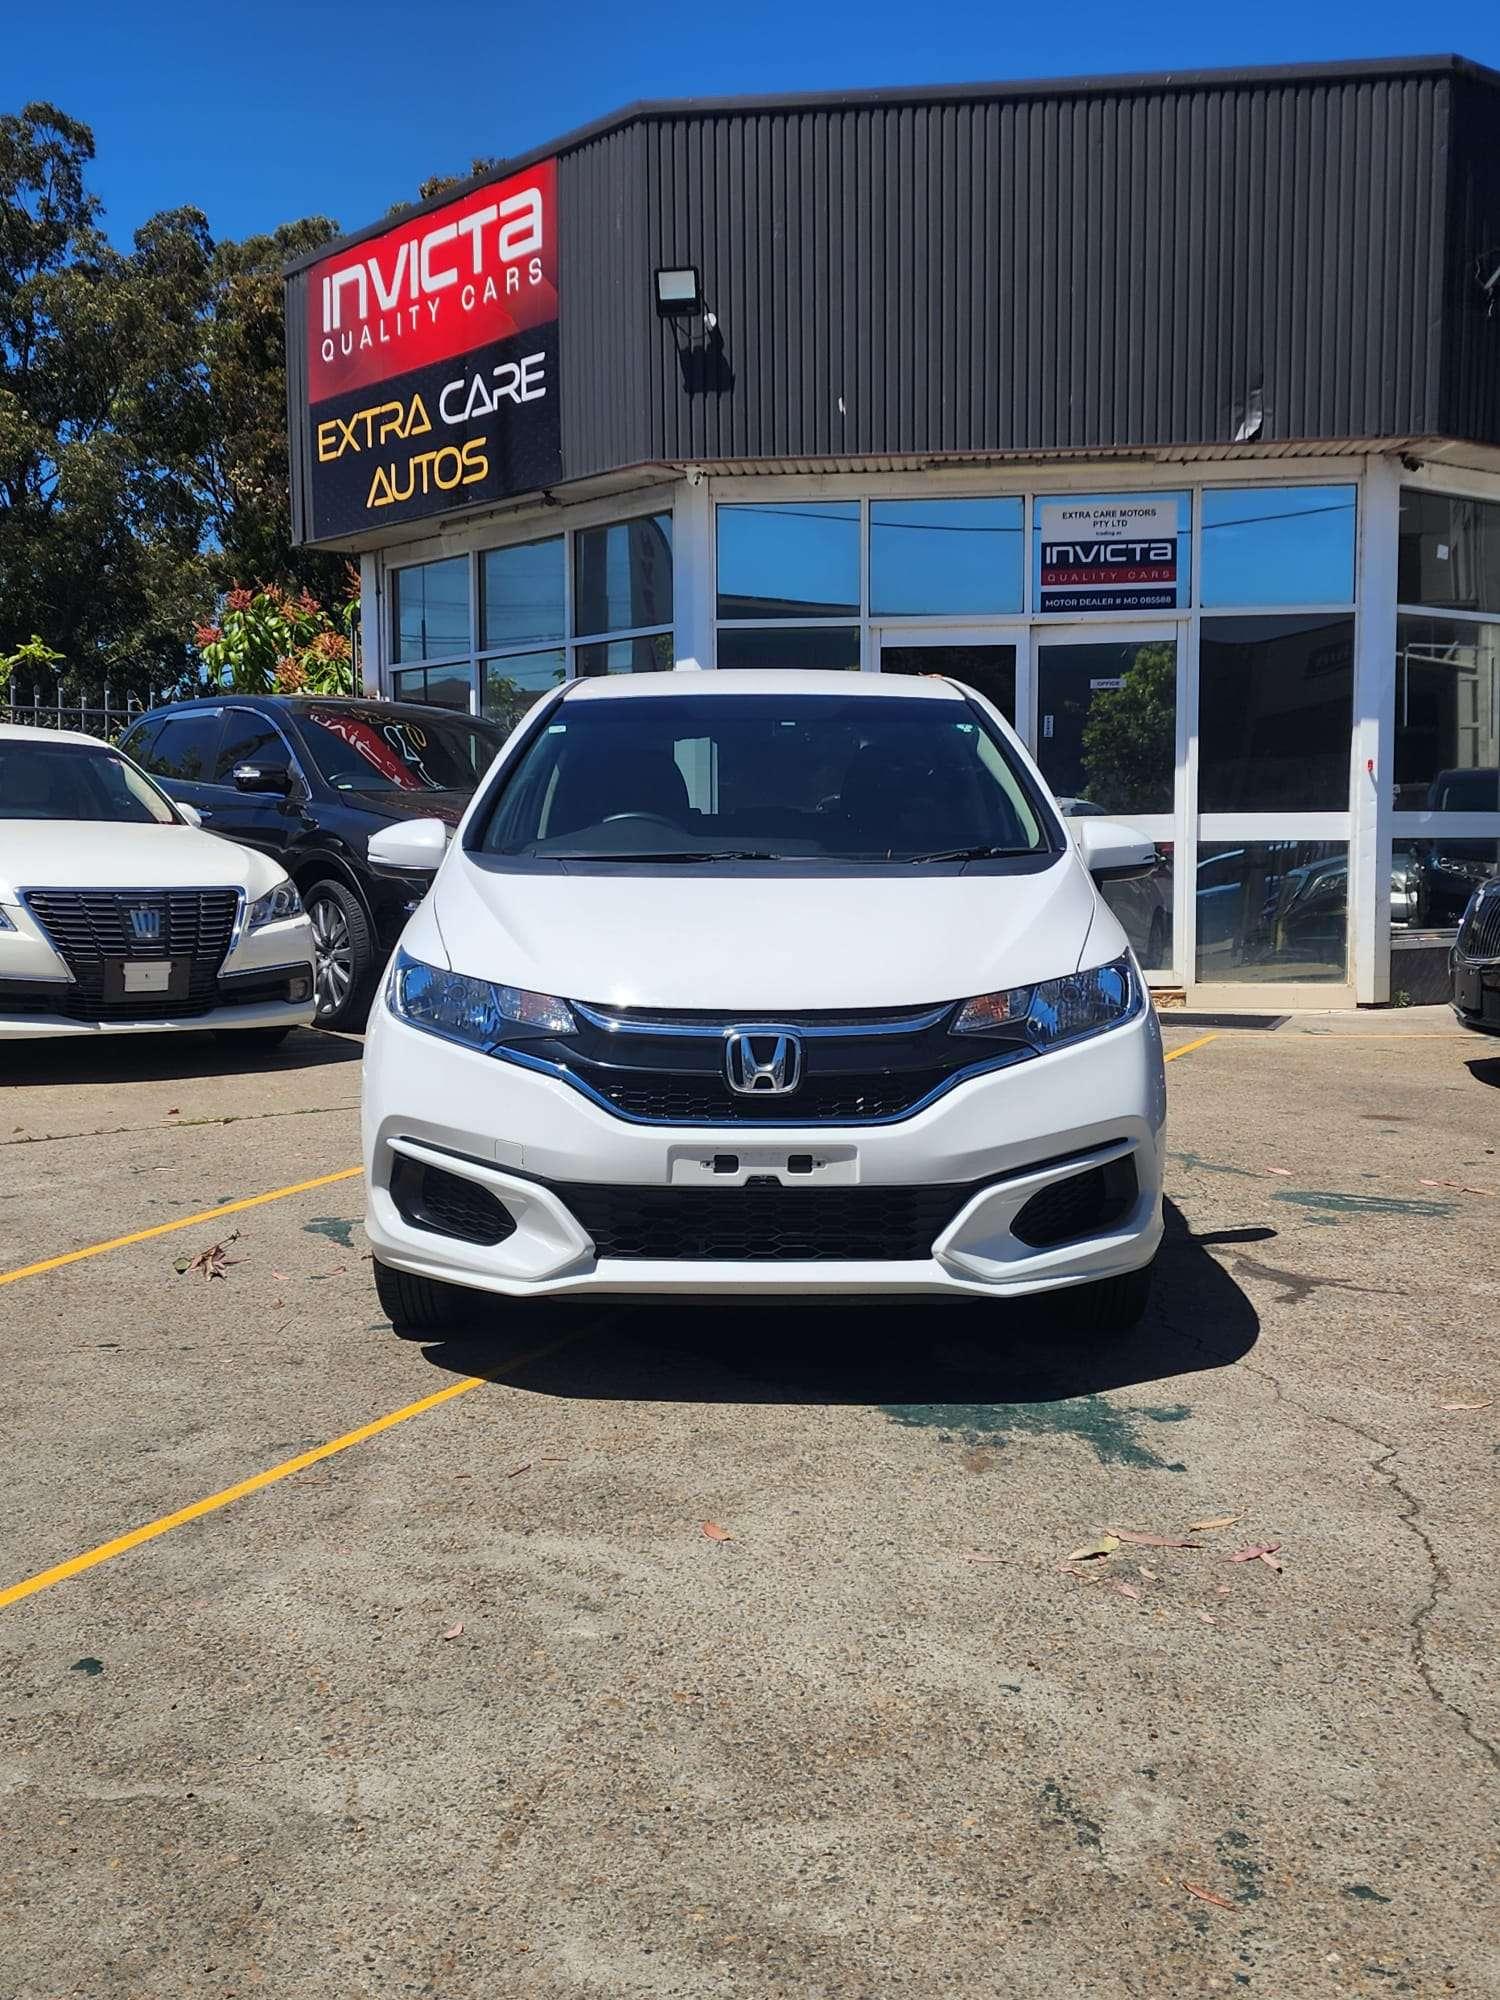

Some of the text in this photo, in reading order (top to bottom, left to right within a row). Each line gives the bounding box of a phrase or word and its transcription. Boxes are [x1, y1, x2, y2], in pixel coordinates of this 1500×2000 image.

[321, 257, 543, 362] QUALITY CARS
[317, 351, 547, 464] EXTRA CARE
[366, 436, 490, 509] AUTOS
[1062, 508, 1157, 519] EXTRA CARE MOTORS
[1093, 519, 1128, 528] PTY LTD
[1047, 570, 1170, 582] QUALITY CARS
[1045, 598, 1077, 607] MOTOR
[1079, 597, 1114, 606] DEALER
[1123, 597, 1138, 605] MD
